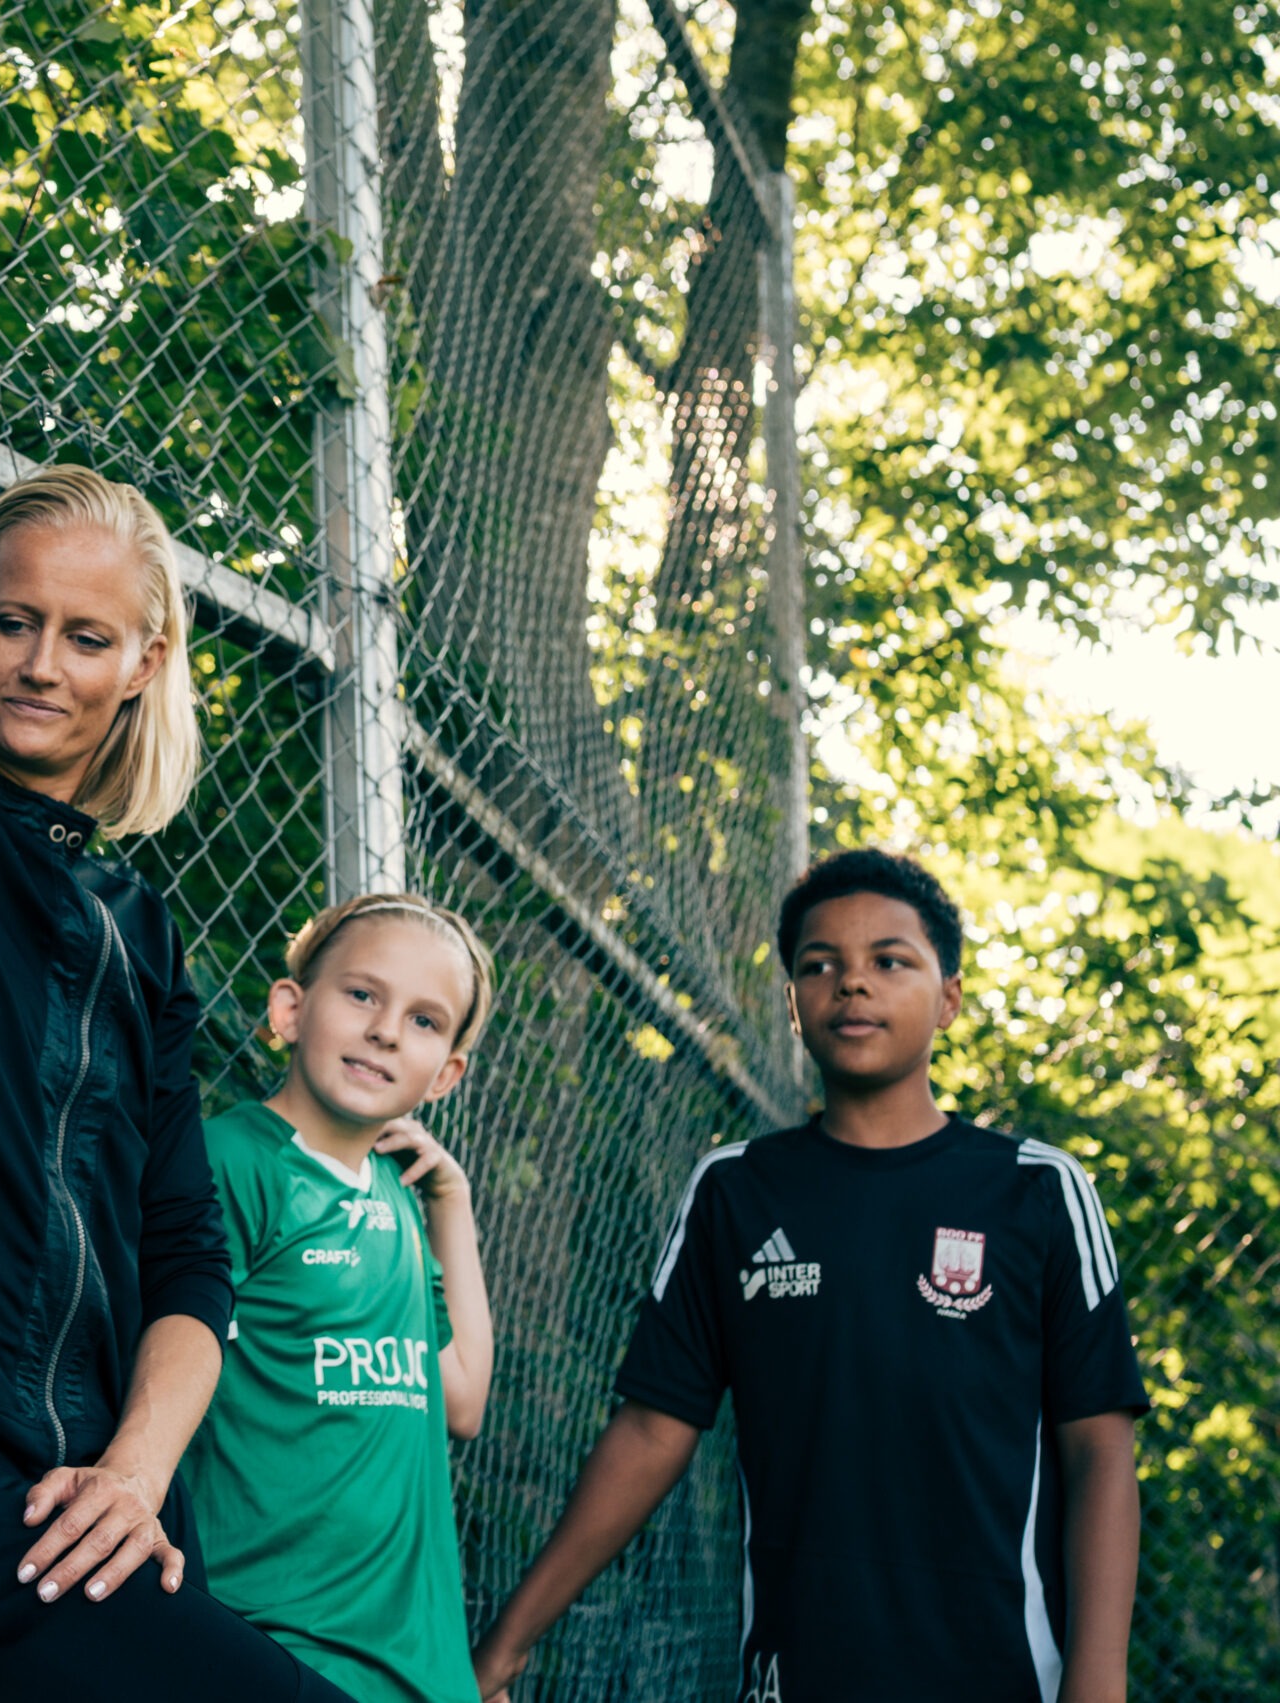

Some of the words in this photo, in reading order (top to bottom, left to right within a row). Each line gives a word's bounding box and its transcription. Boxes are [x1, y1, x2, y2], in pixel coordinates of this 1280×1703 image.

[366, 1214, 397, 1231] PORT
[302, 1249, 351, 1264] CRAFT
[767, 1263, 821, 1283] INTER
[768, 1279, 822, 1298] SPORT
